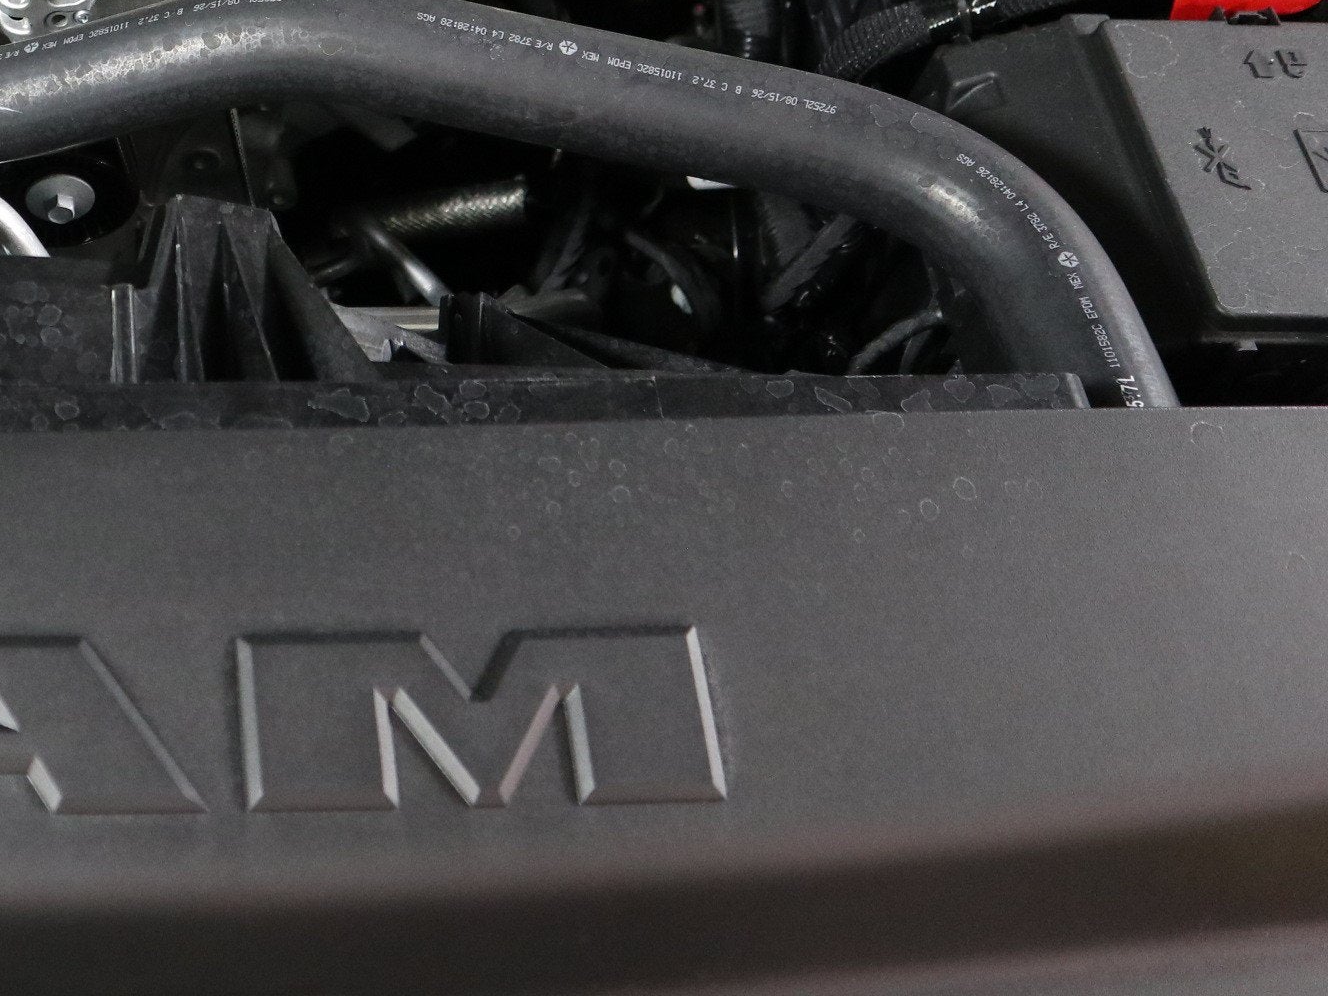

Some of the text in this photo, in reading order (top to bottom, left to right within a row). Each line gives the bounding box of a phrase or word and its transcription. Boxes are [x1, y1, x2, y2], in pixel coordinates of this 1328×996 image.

[137, 14, 160, 26] 37.2
[416, 12, 436, 23] AGS
[491, 29, 505, 39] L4
[508, 32, 533, 46] 3782
[535, 40, 554, 51] R/E
[581, 50, 600, 62] MEX
[606, 56, 632, 70] EPDM
[636, 62, 683, 81] 1101582C
[691, 75, 717, 89] 37.2
[751, 88, 798, 106] 08/15/26
[802, 98, 837, 114] 97252L
[955, 153, 976, 167] AGS
[1014, 199, 1029, 212] L4
[1026, 212, 1048, 233] 3782
[1041, 232, 1061, 250] R/E
[1066, 271, 1084, 290] MEX
[1078, 295, 1099, 320] EPDM
